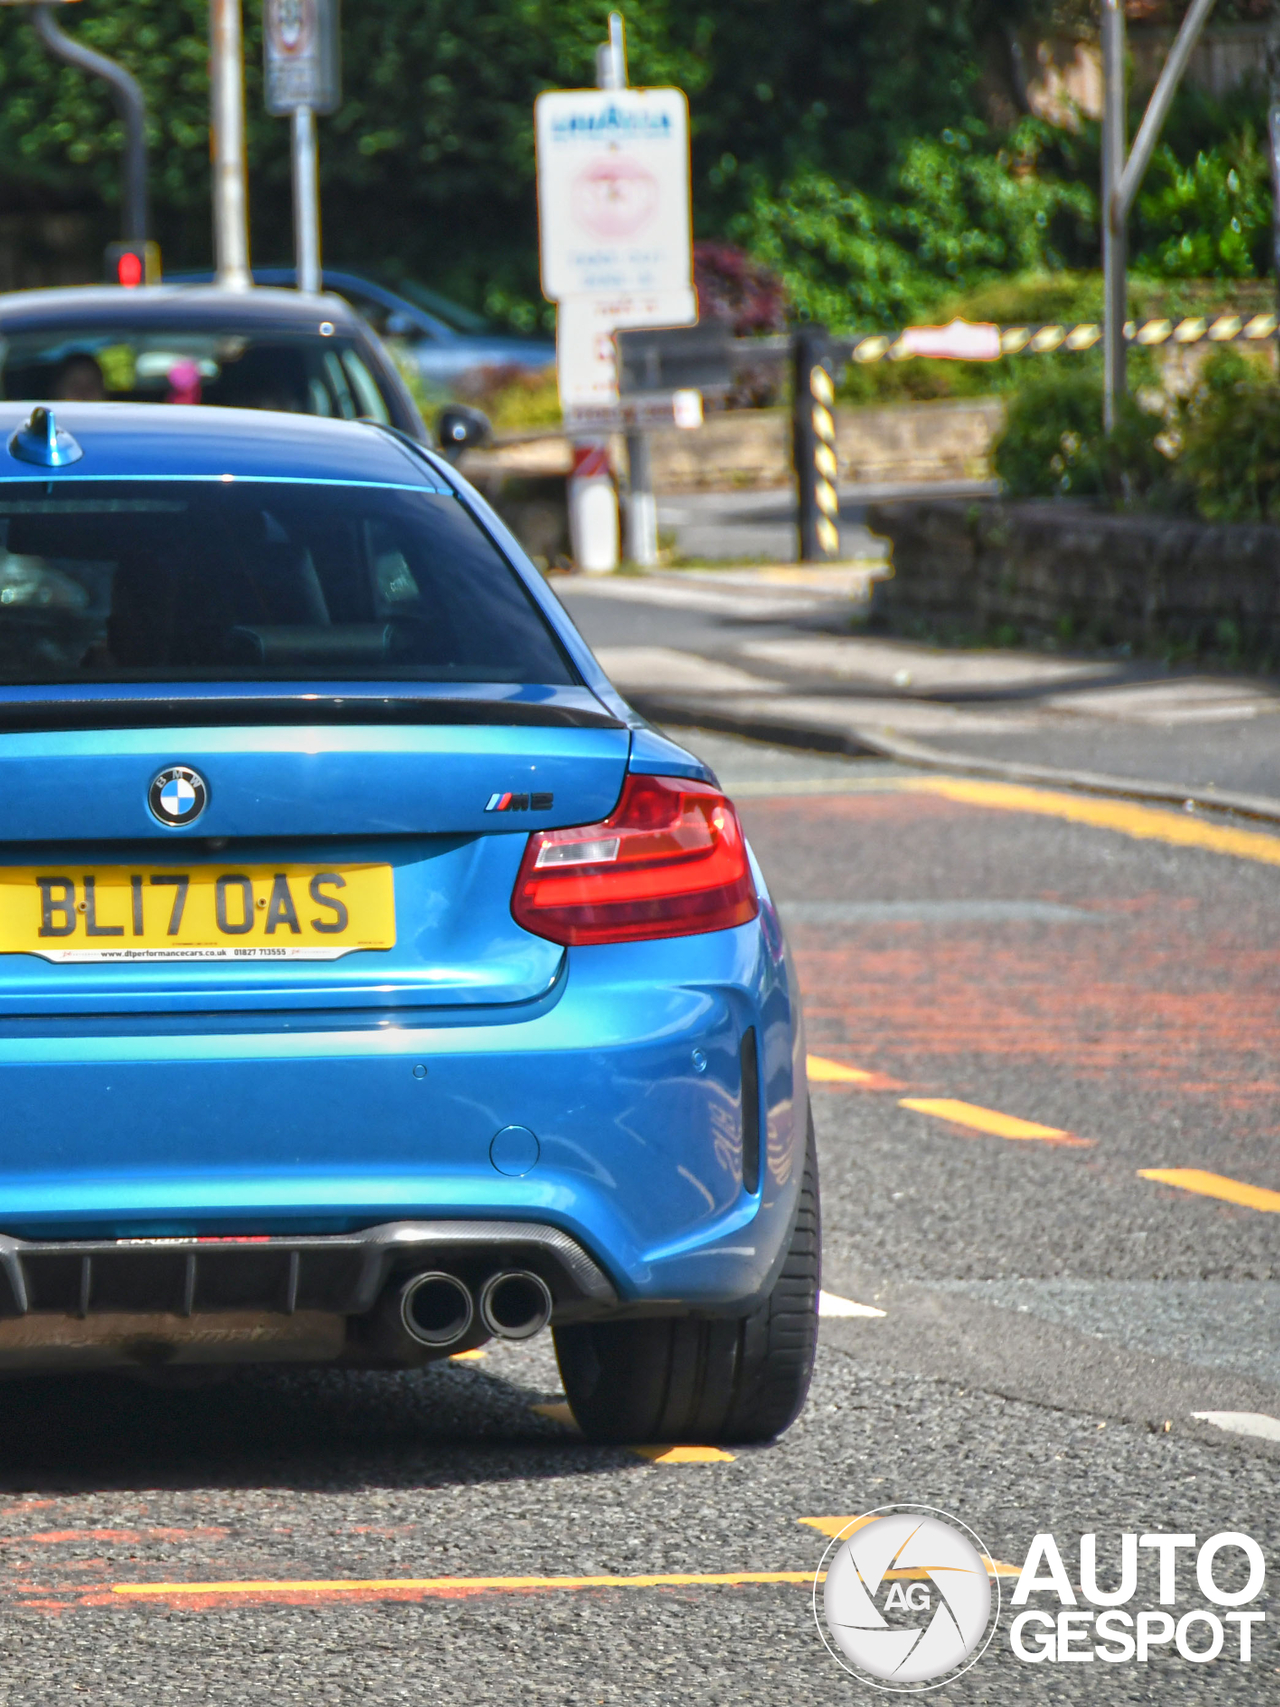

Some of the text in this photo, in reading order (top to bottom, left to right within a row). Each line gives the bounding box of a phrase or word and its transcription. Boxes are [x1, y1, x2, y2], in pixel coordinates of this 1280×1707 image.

[156, 769, 202, 789] BMW
[36, 873, 349, 937] BL17 OAS
[233, 948, 257, 956] 01827
[259, 948, 287, 956] 713555
